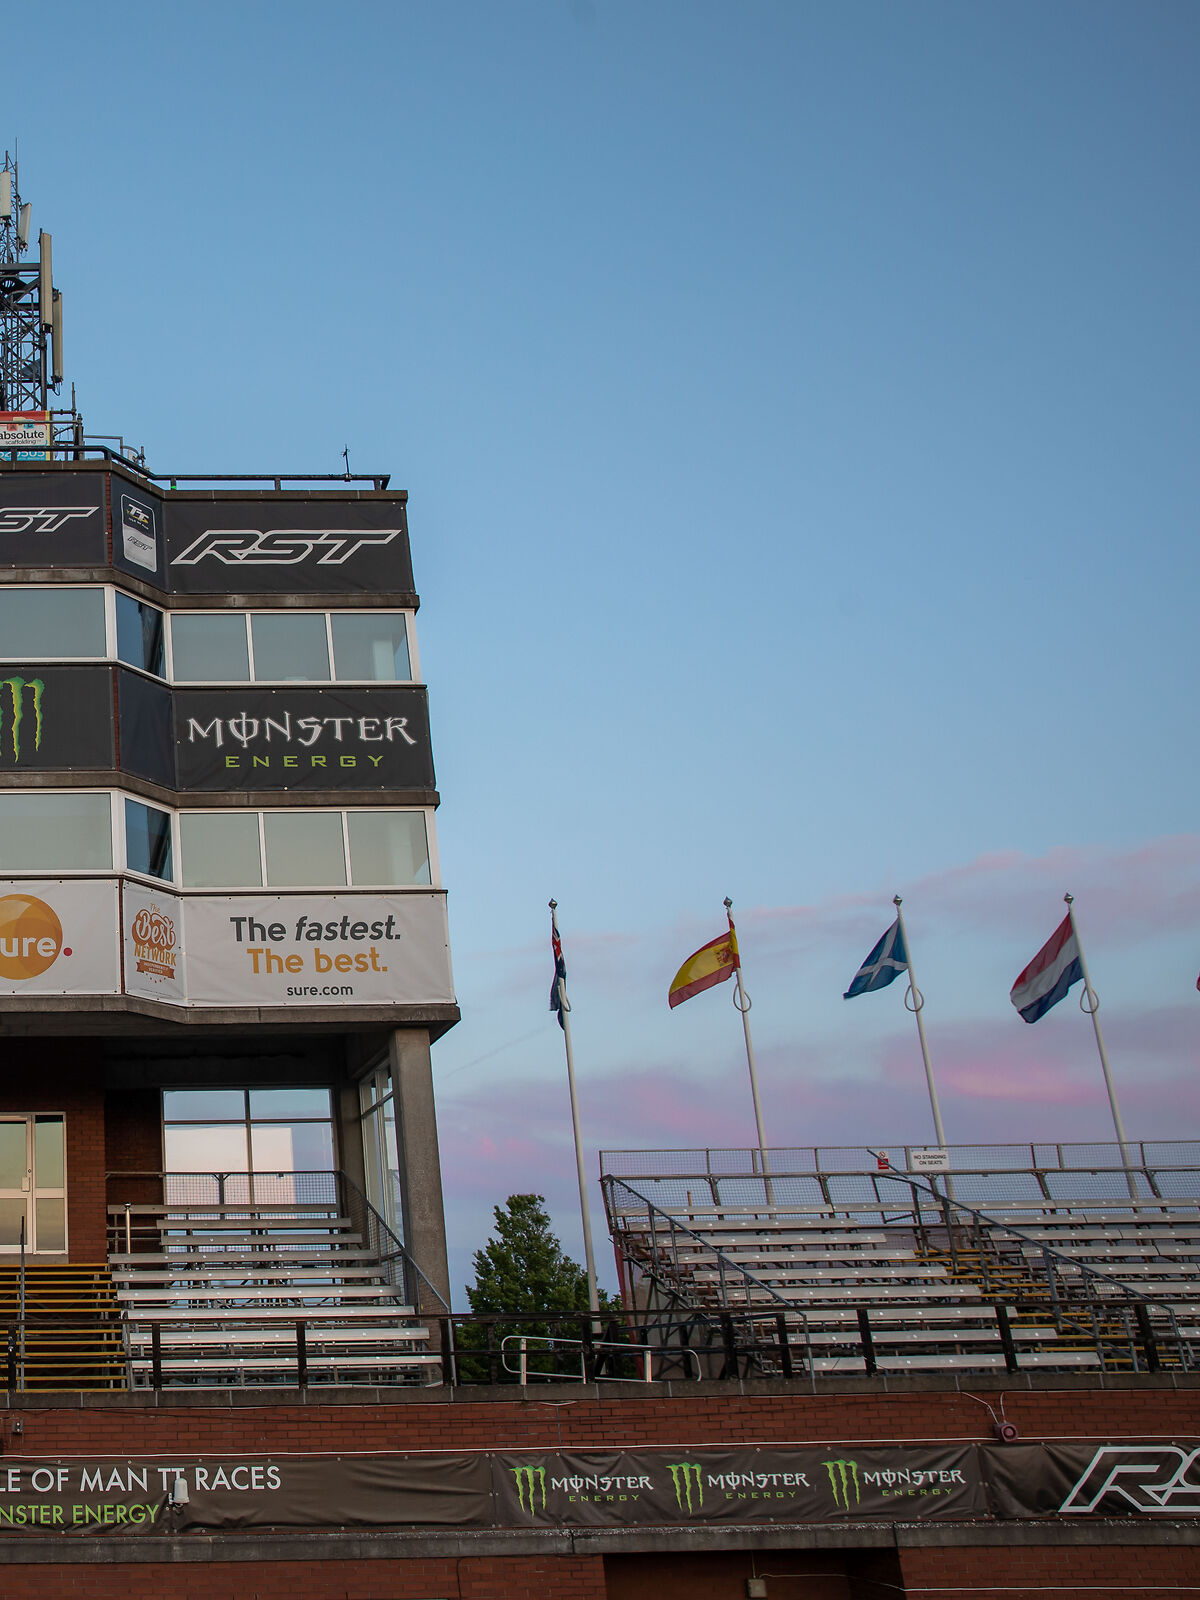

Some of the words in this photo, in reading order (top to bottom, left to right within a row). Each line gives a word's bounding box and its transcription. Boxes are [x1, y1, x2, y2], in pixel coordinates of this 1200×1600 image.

[170, 529, 402, 565] RST
[186, 711, 418, 749] MONSTER
[225, 755, 385, 769] ENERGY
[134, 910, 176, 949] Best
[230, 916, 287, 942] The
[295, 915, 401, 941] fastest.
[134, 943, 177, 967] NETWORK
[247, 948, 304, 974] The
[314, 947, 388, 973] best.
[287, 984, 354, 997] sure.com
[31, 1468, 69, 1492] OF
[79, 1467, 148, 1492] MAN
[195, 1465, 282, 1491] RACES
[550, 1474, 654, 1493] MONSTER
[707, 1471, 811, 1490] MONSTER
[863, 1464, 966, 1487] MONSTER
[568, 1494, 640, 1502] ENERGY
[725, 1491, 797, 1499] ENERGY
[882, 1488, 953, 1497] ENERGY
[72, 1503, 160, 1524] ENERGY
